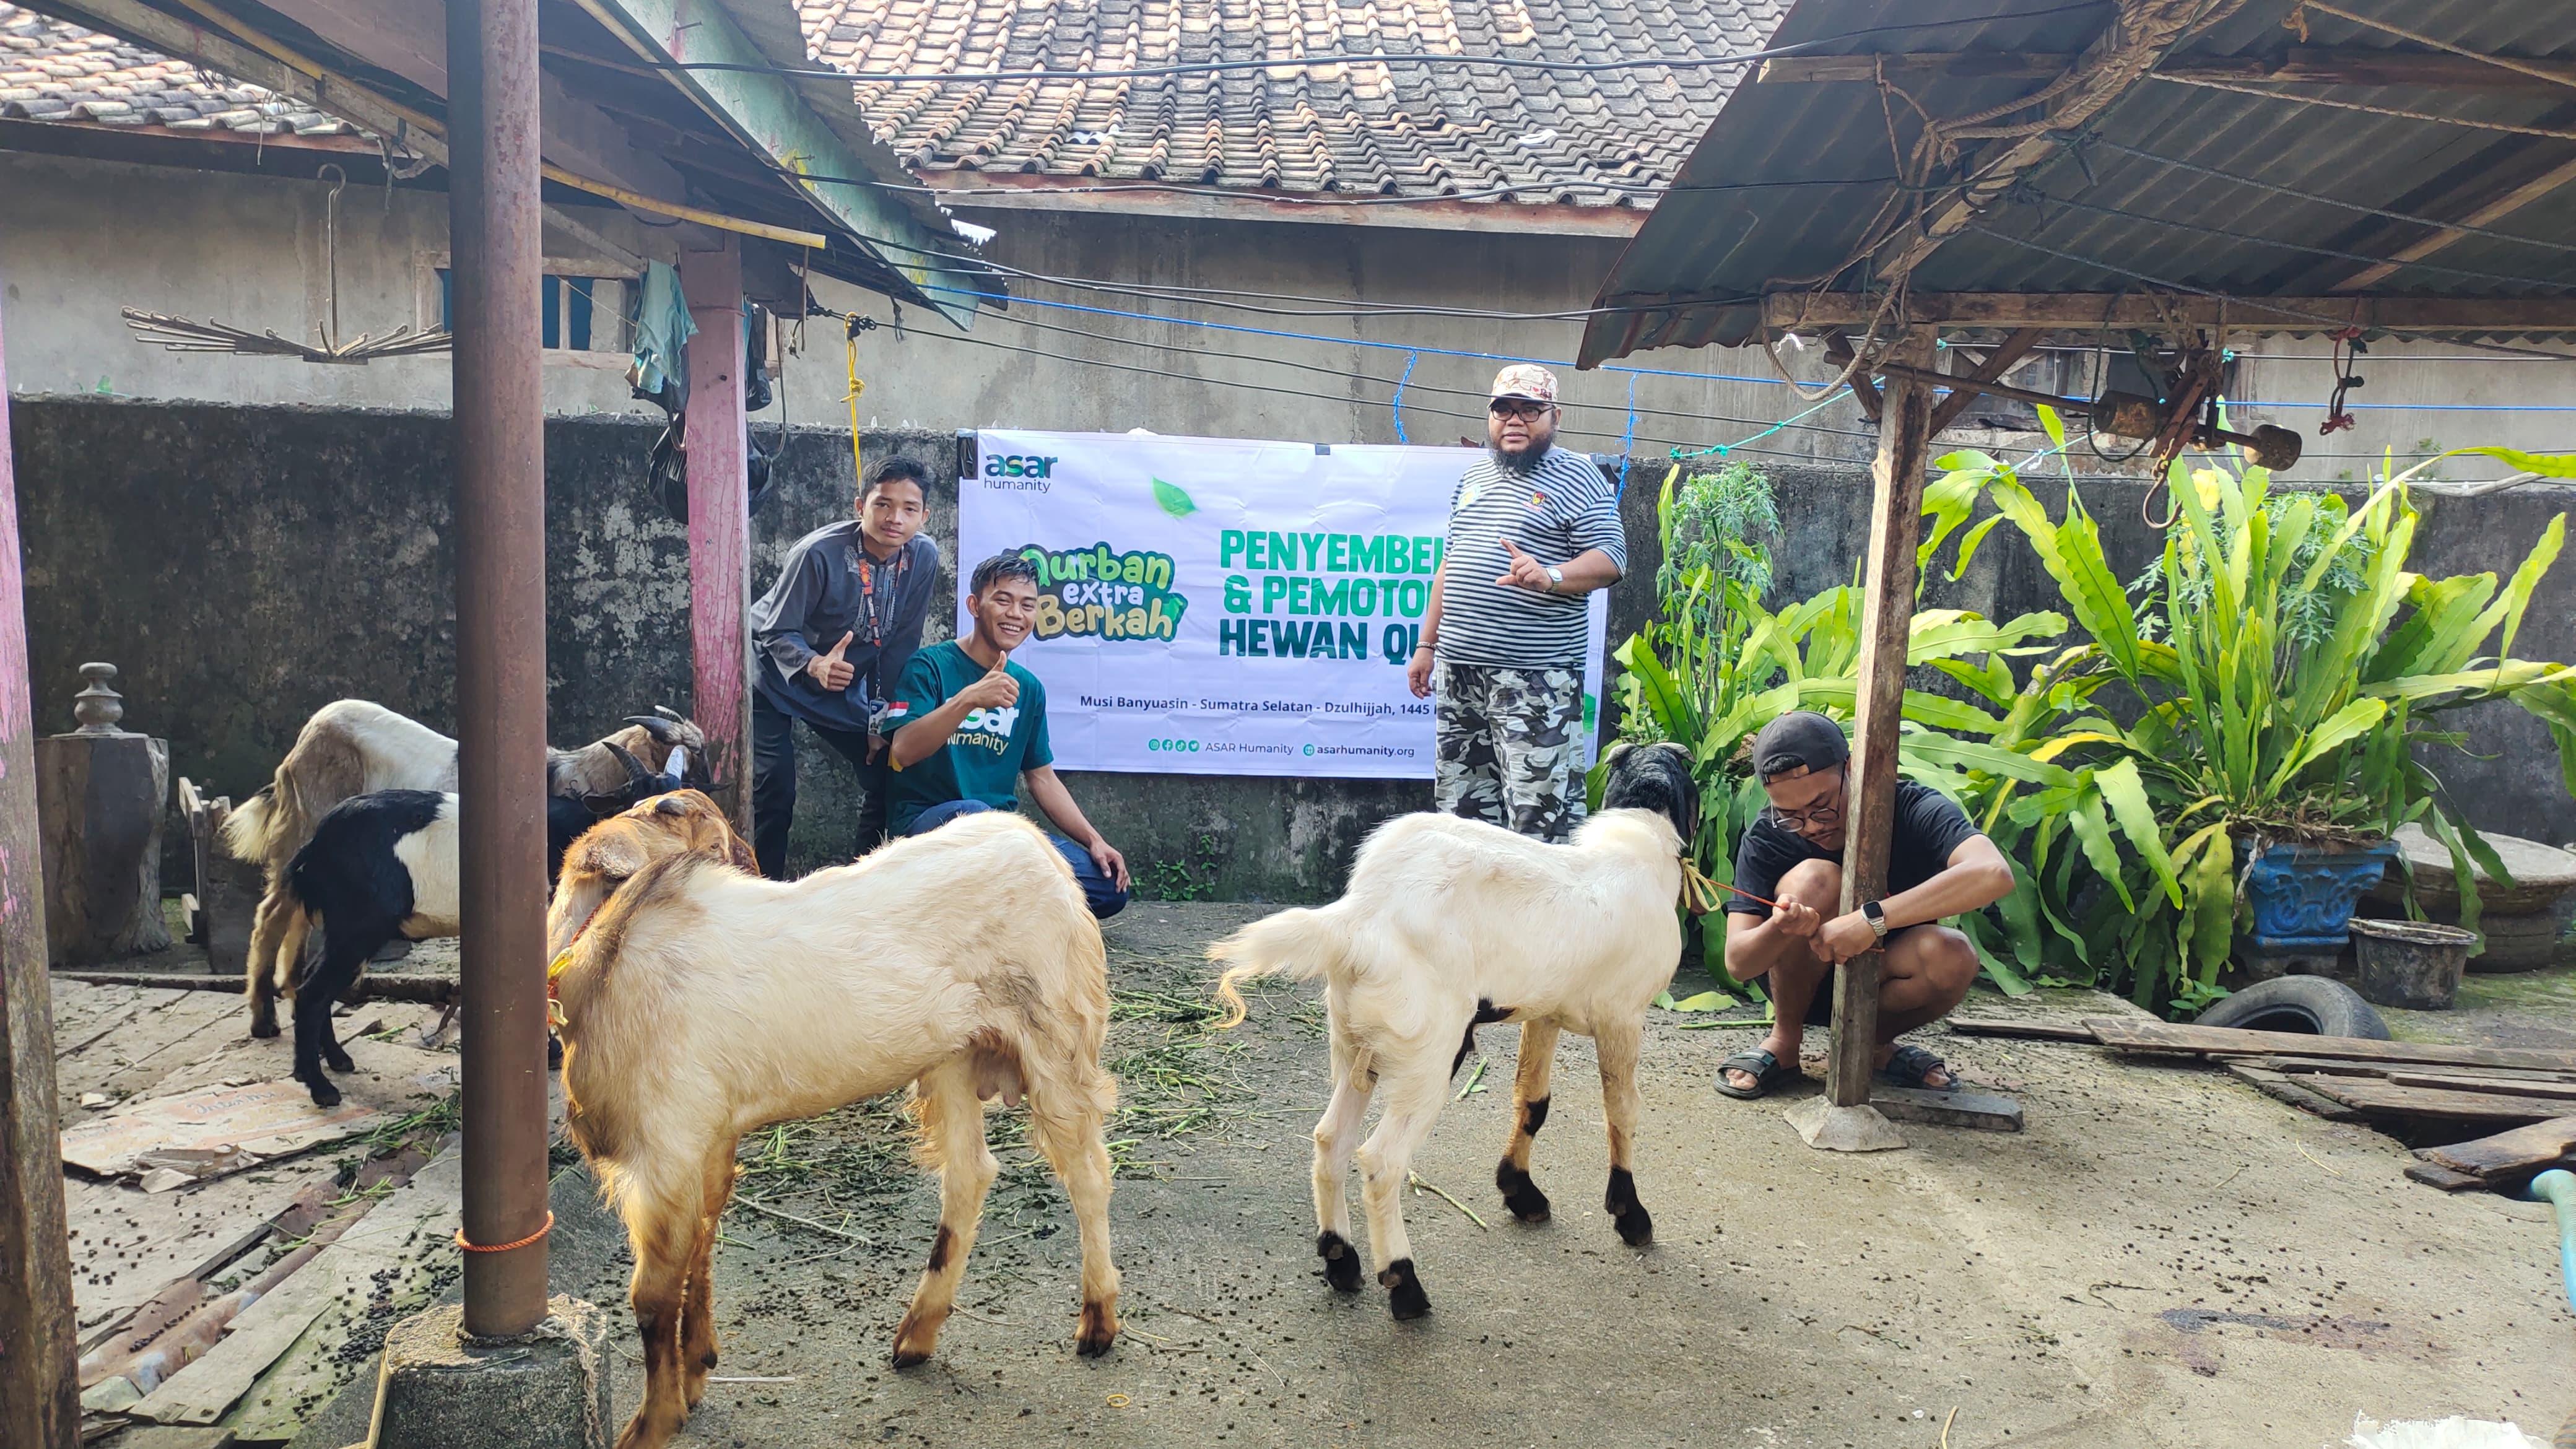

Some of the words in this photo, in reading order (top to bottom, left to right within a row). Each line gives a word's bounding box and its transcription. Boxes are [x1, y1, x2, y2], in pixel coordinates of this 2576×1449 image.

[985, 454, 1058, 479] asar
[984, 477, 1051, 494] humanity
[1063, 581, 1144, 606] extra
[1224, 575, 1252, 614] &
[1263, 576, 1434, 618] PEMOTO
[1035, 594, 1173, 637] Berkah
[1219, 619, 1368, 660] HEWAN
[946, 697, 1020, 738] sar
[1080, 695, 1113, 707] Musi
[1117, 697, 1188, 711] Banyuasin
[1200, 698, 1258, 711] Sumatra
[1262, 700, 1313, 712] Selatan
[1325, 702, 1396, 716] Dzulhijjah,
[1400, 703, 1430, 715] 1445
[947, 732, 1009, 755] umanity
[1205, 742, 1236, 752] ASAR
[1239, 743, 1294, 755] Humanity
[1317, 745, 1415, 758] asarhumanity.org
